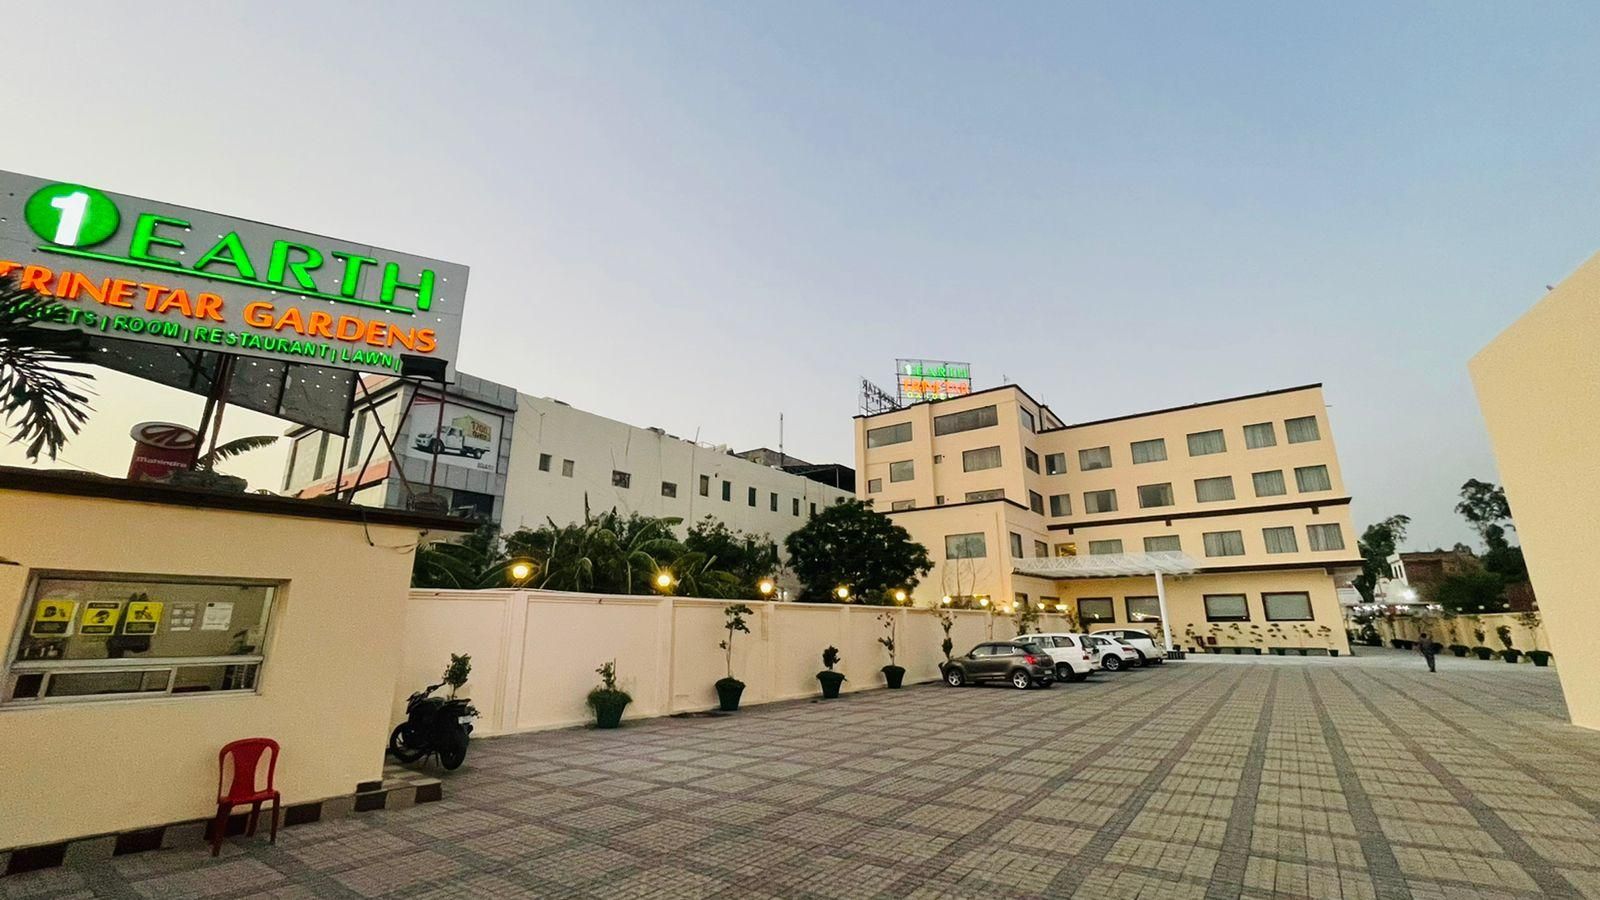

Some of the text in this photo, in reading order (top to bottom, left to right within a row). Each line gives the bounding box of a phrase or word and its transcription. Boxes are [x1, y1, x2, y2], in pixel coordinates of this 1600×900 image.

[51, 191, 435, 311] 1 EARTH
[113, 315, 181, 337] ROOM
[193, 325, 332, 359] RESTAURANT
[341, 348, 395, 367] LAWN
[243, 301, 437, 353] GARDENS
[914, 365, 968, 378] EARTH
